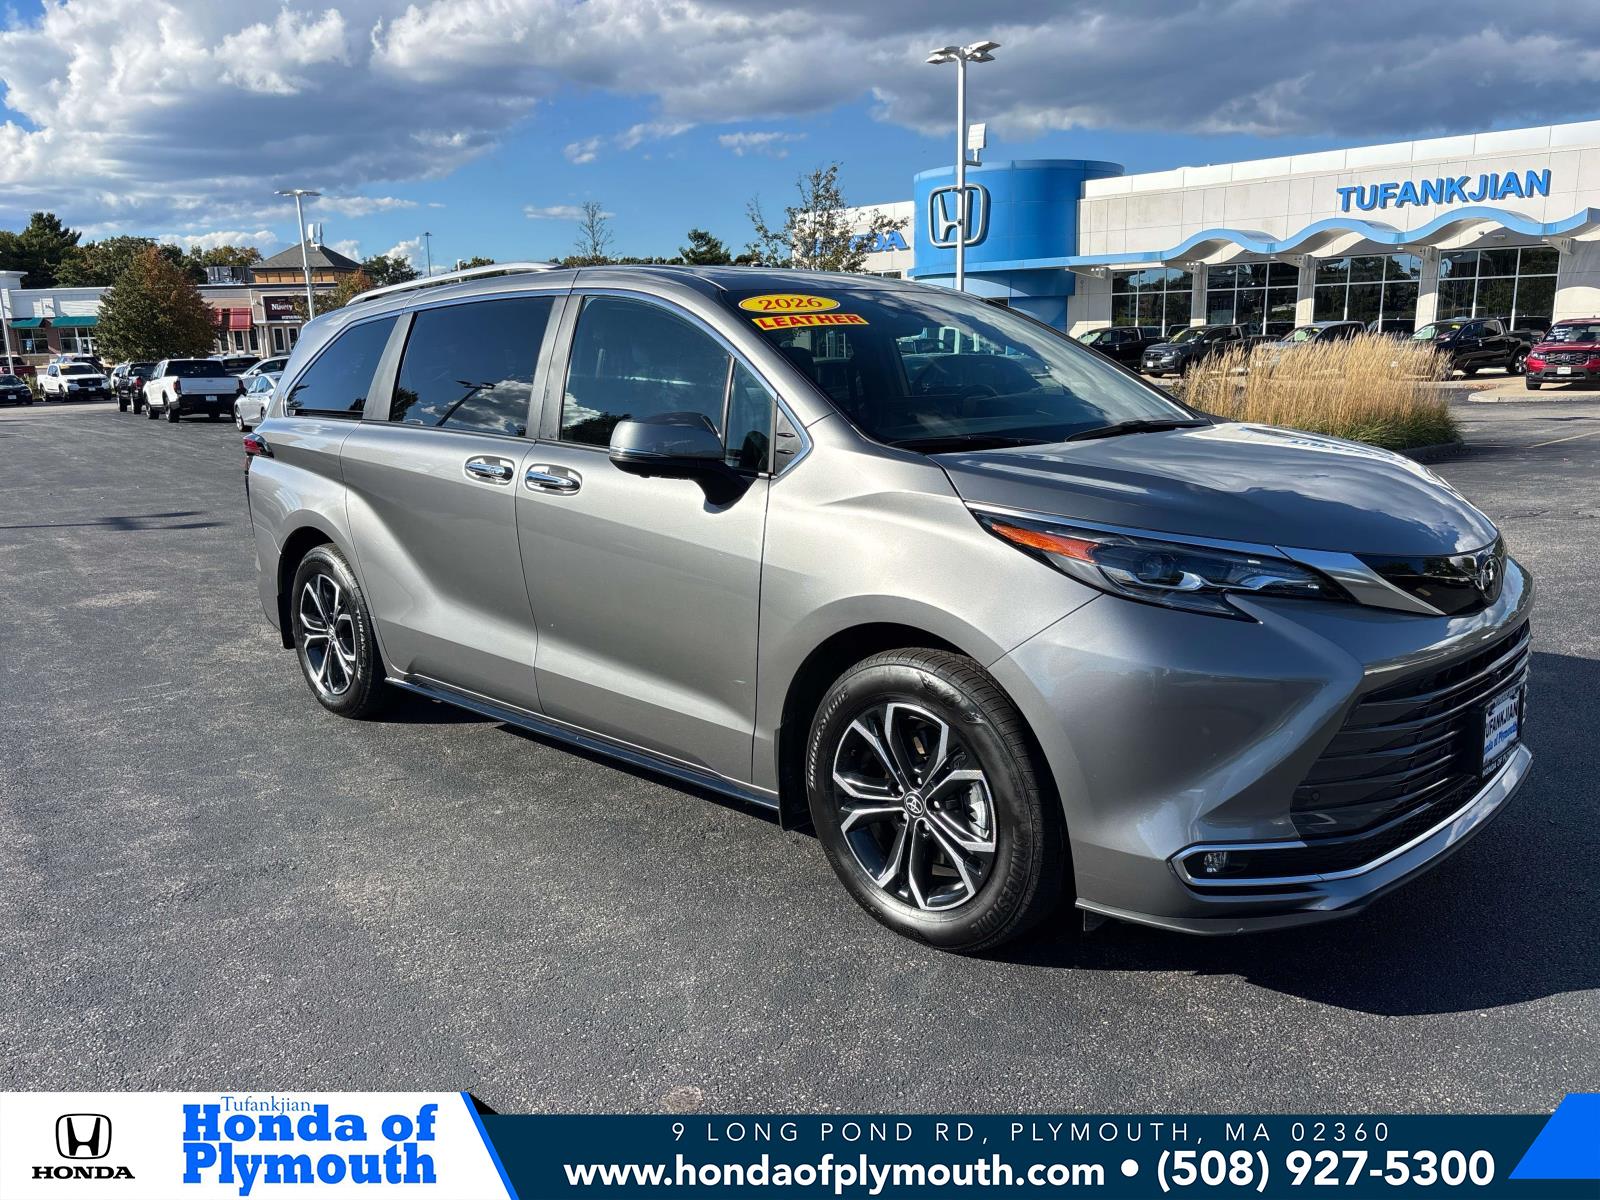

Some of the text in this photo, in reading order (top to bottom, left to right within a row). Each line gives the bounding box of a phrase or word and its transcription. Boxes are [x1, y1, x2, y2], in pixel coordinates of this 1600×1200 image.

[1336, 168, 1551, 213] TUFANKJIAN
[758, 297, 823, 311] 2026
[758, 314, 864, 329] LEATHER
